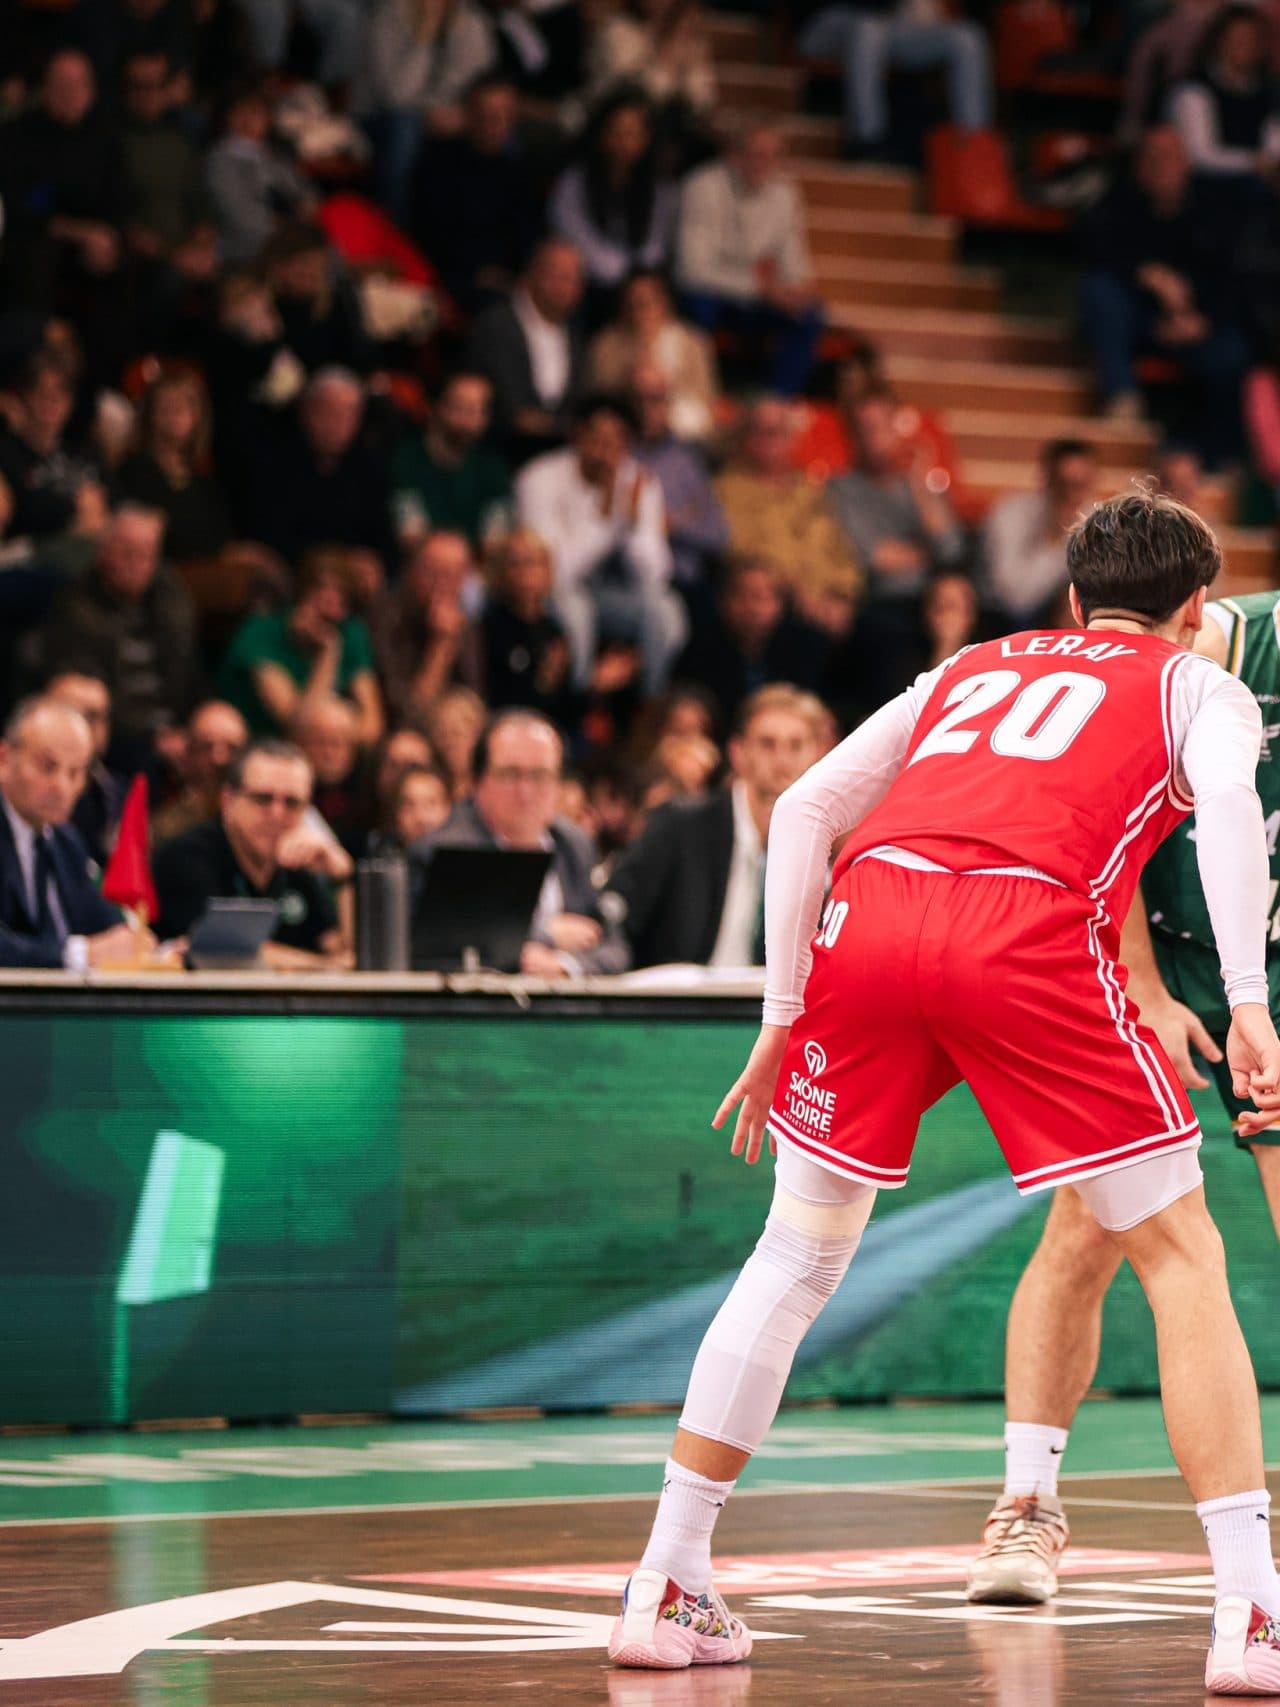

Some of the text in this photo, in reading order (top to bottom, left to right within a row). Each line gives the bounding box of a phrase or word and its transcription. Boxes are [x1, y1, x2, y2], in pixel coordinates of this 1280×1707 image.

[1001, 635, 1139, 662] LERAY
[906, 670, 1107, 770] 20
[790, 1094, 833, 1133] LOIRE
